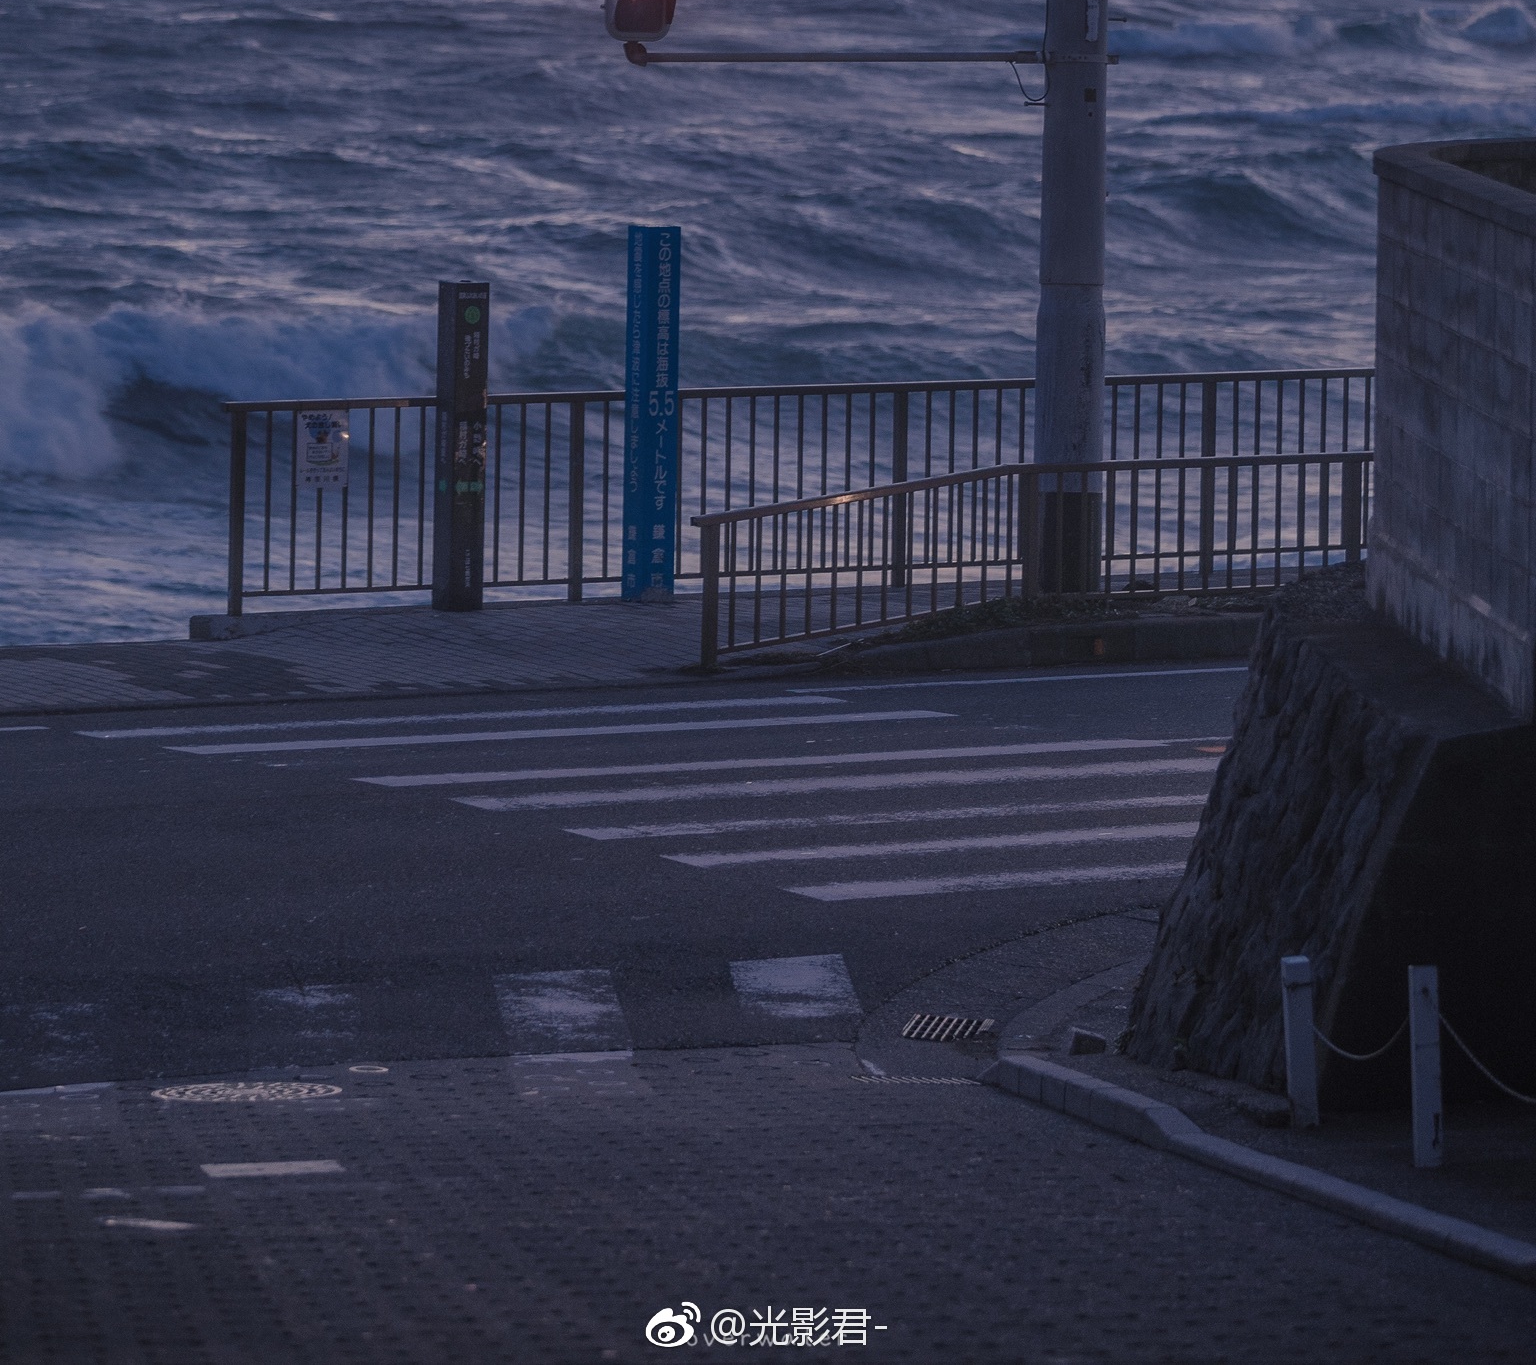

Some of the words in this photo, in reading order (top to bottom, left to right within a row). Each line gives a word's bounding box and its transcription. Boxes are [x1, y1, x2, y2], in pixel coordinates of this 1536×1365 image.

[648, 232, 675, 512] この地点の標高は海抜5.5メートルです
[626, 525, 639, 588] 鎌倉市
[651, 524, 666, 587] 鎌倉市
